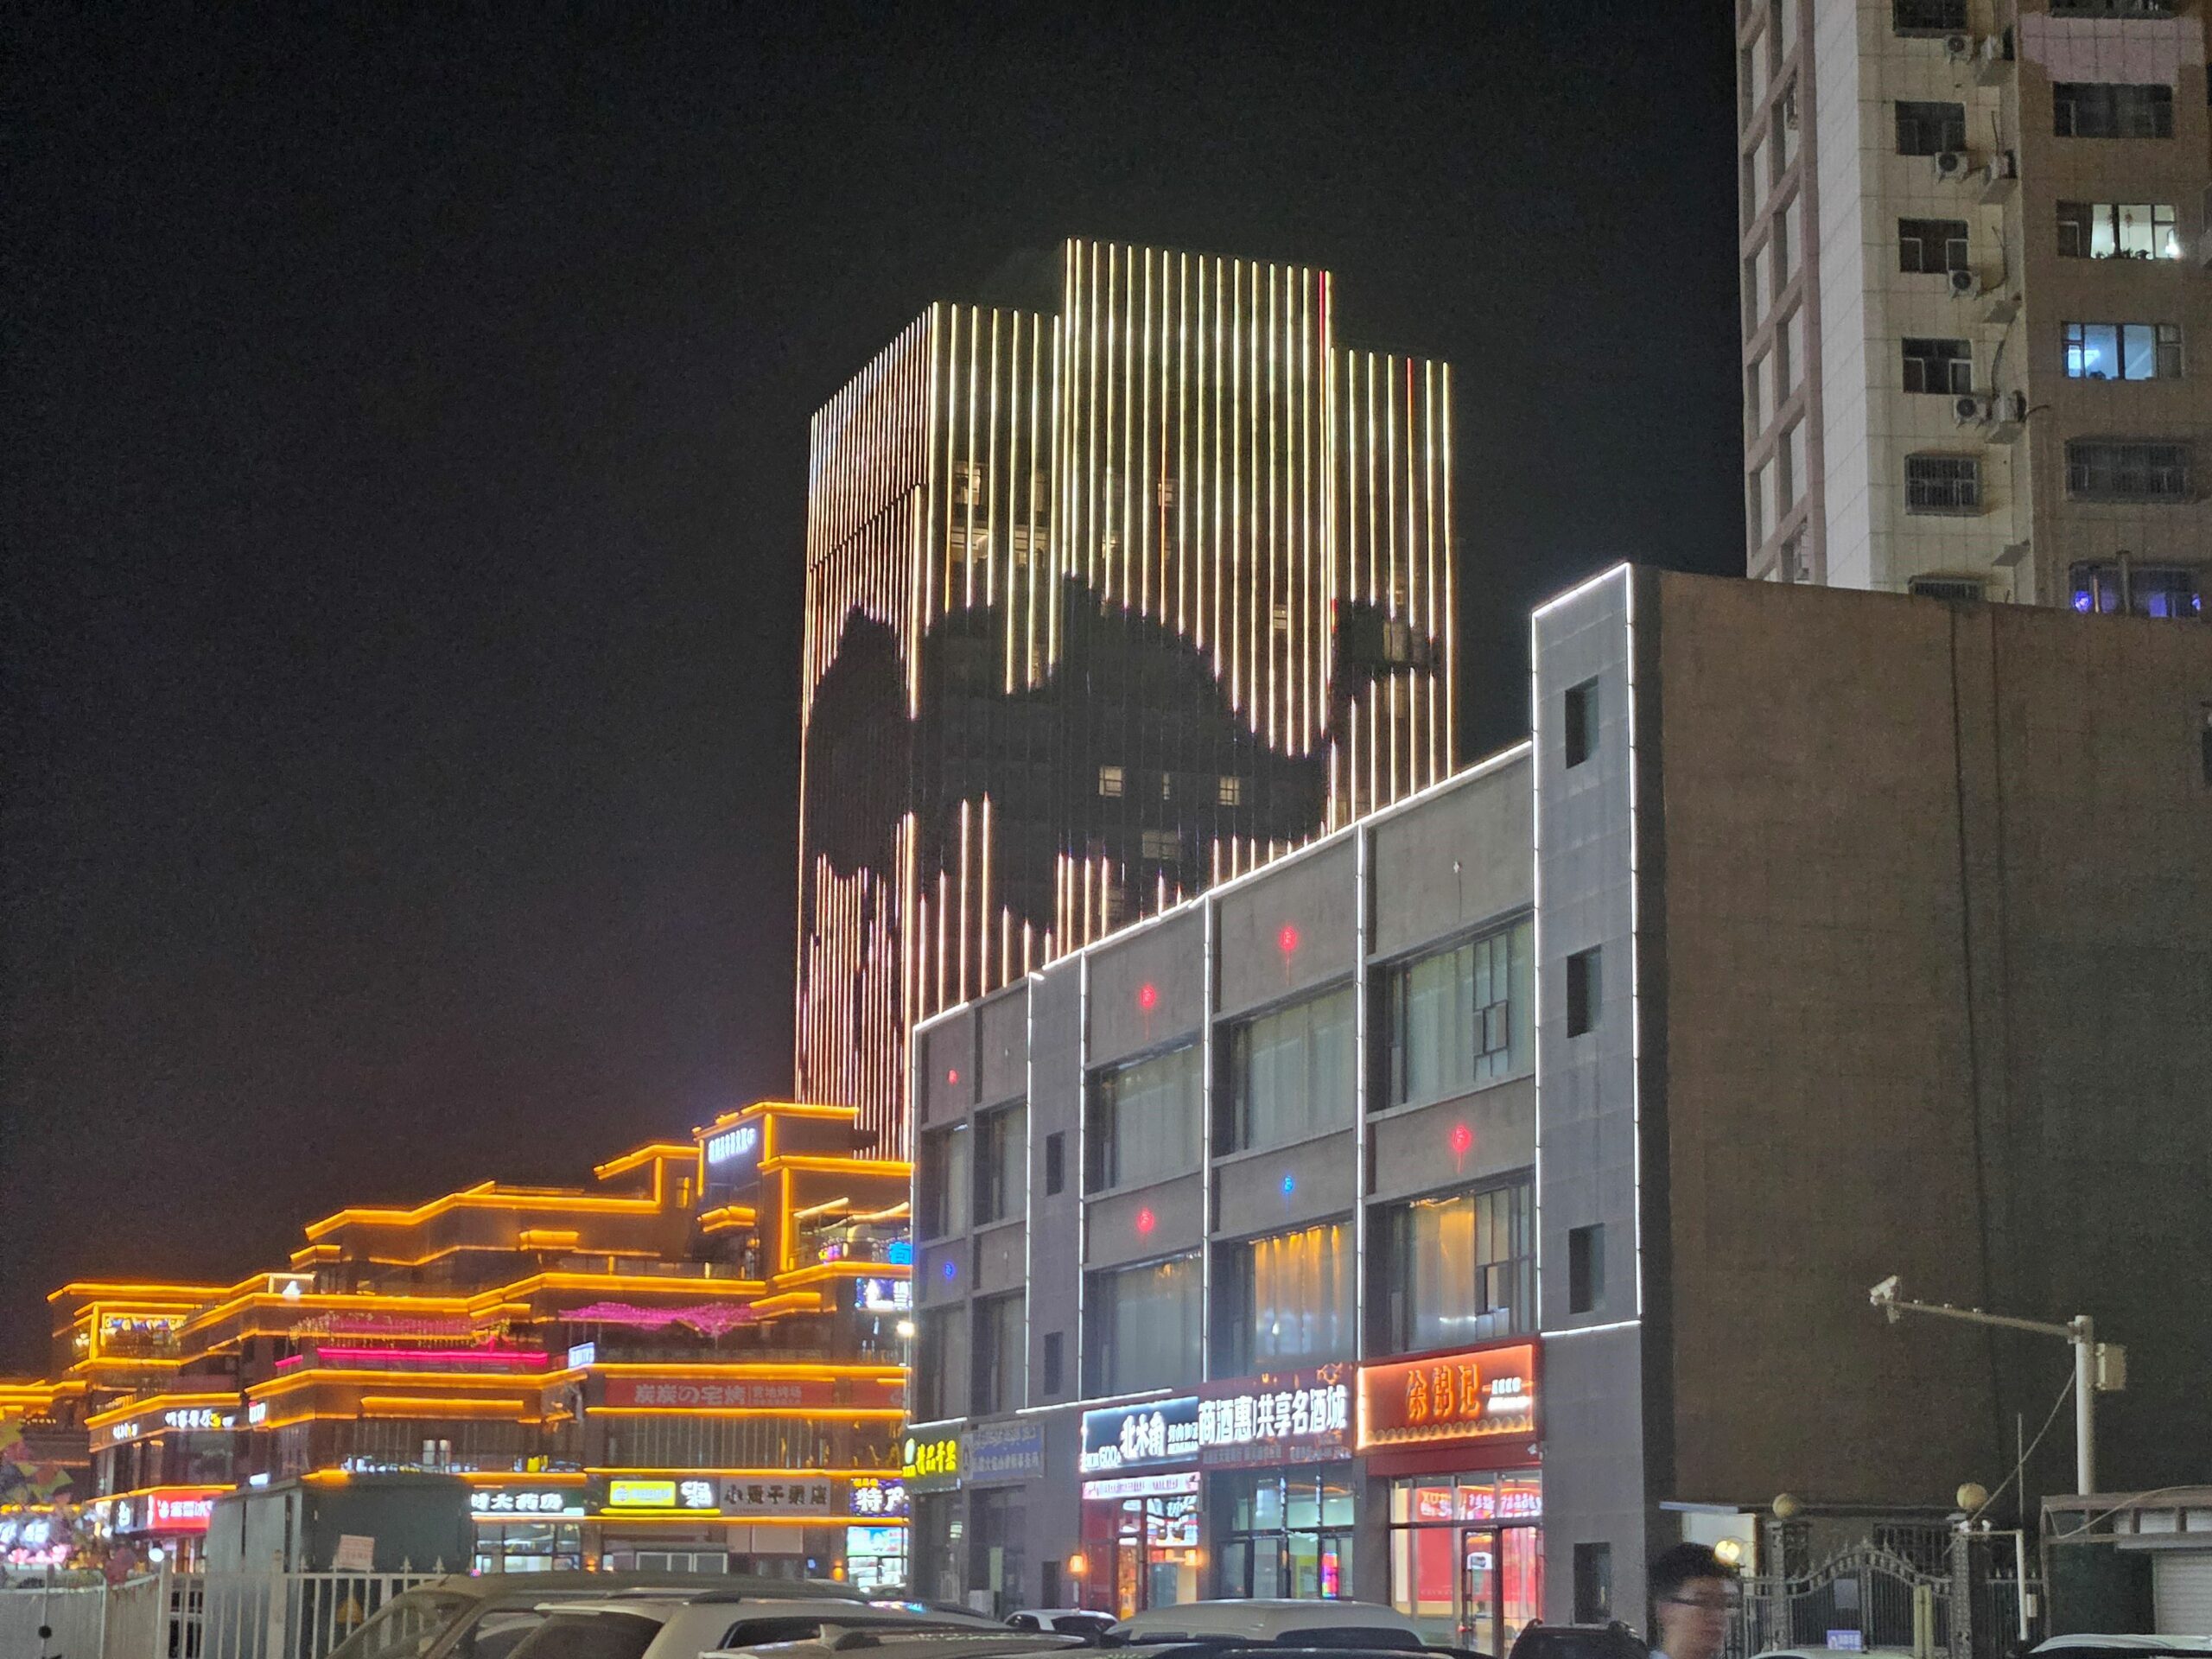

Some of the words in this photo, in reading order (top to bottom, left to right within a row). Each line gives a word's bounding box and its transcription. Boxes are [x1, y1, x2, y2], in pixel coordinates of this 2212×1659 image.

[1256, 1384, 1348, 1439] 共享名酒城
